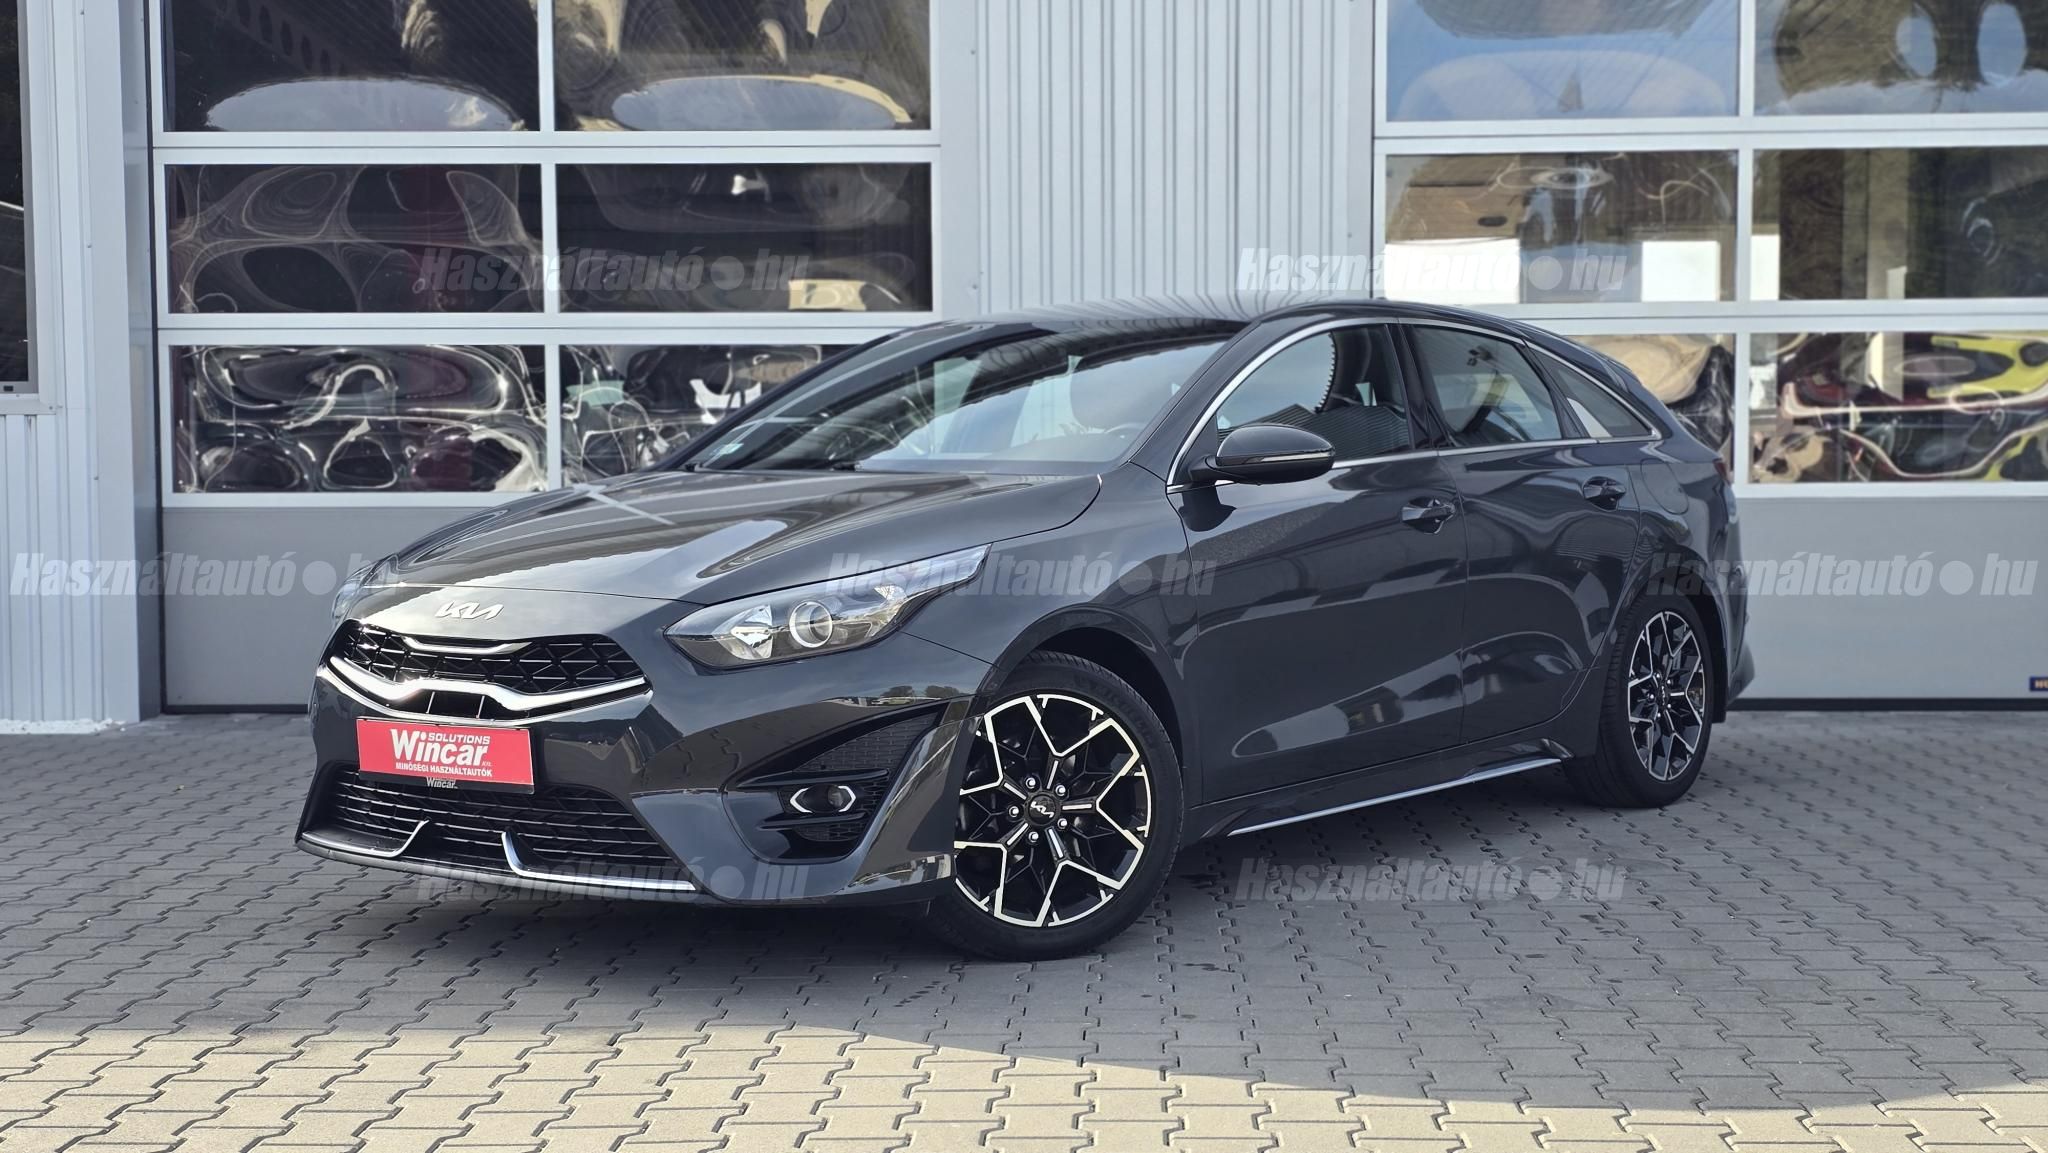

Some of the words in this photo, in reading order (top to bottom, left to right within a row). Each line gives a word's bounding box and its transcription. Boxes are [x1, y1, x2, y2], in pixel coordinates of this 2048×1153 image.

[428, 732, 490, 745] SOLUTIONS
[390, 729, 489, 766] Wincar
[430, 764, 492, 777] HASZNÁLTAUTÓK
